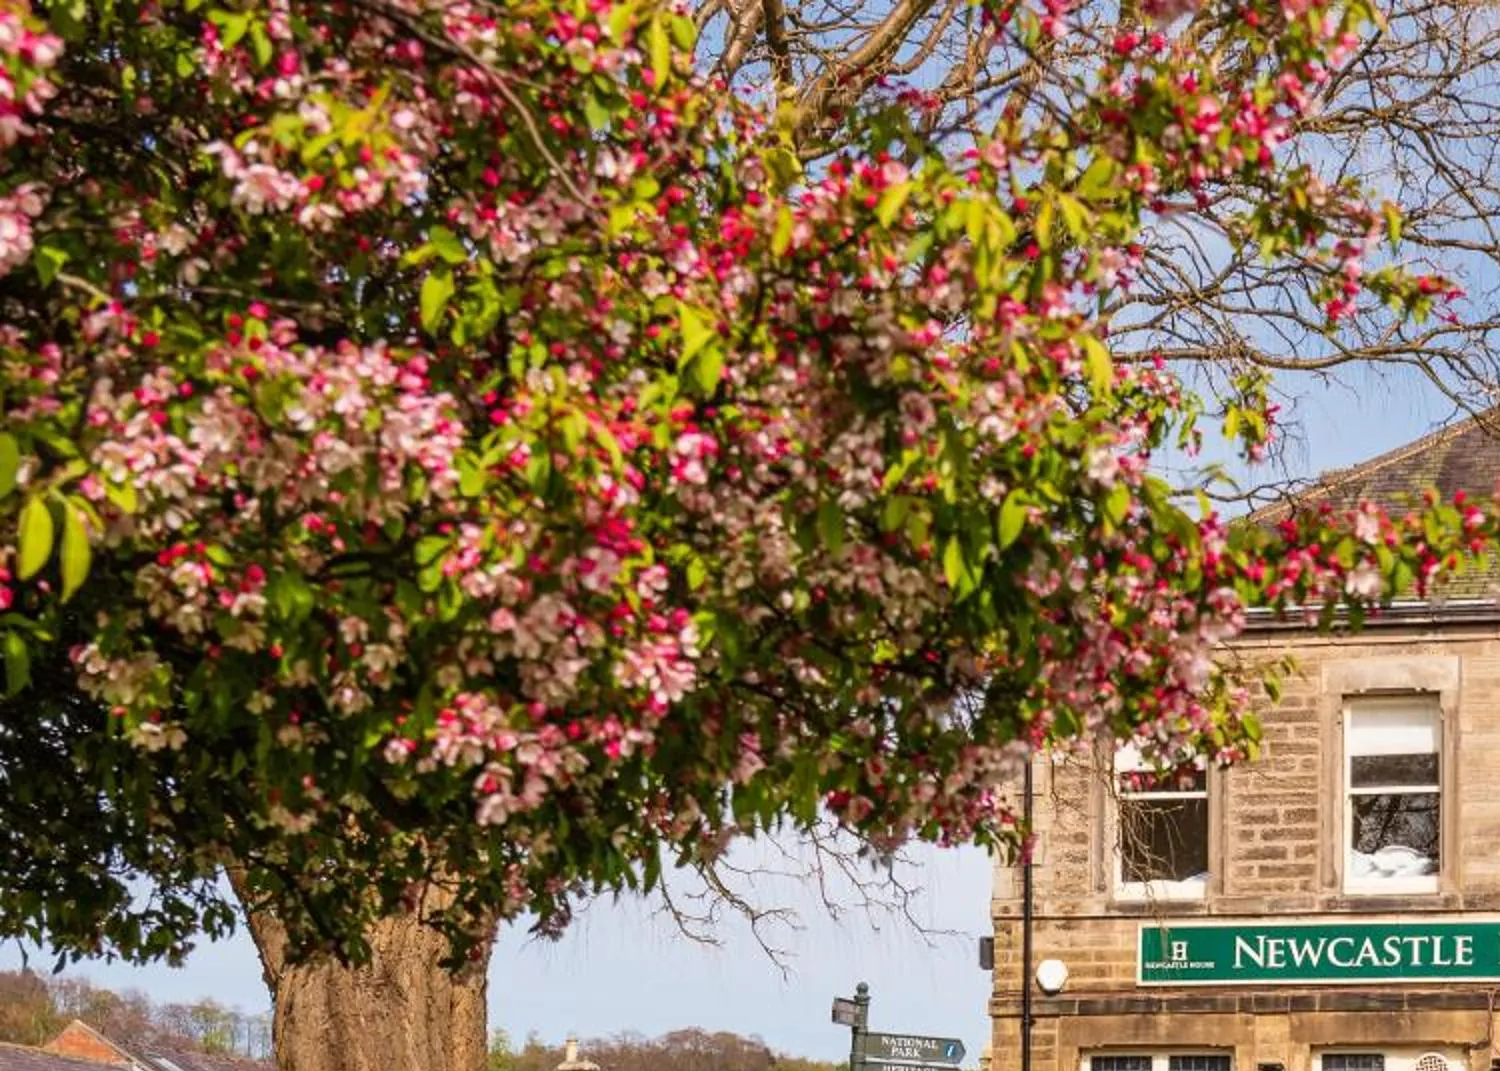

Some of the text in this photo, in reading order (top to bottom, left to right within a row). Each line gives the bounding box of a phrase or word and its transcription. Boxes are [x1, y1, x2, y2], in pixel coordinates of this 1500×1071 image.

[1232, 935, 1474, 968] NEWCASTLE
[882, 1036, 938, 1049] NATIONAL
[891, 1047, 920, 1057] PARK
